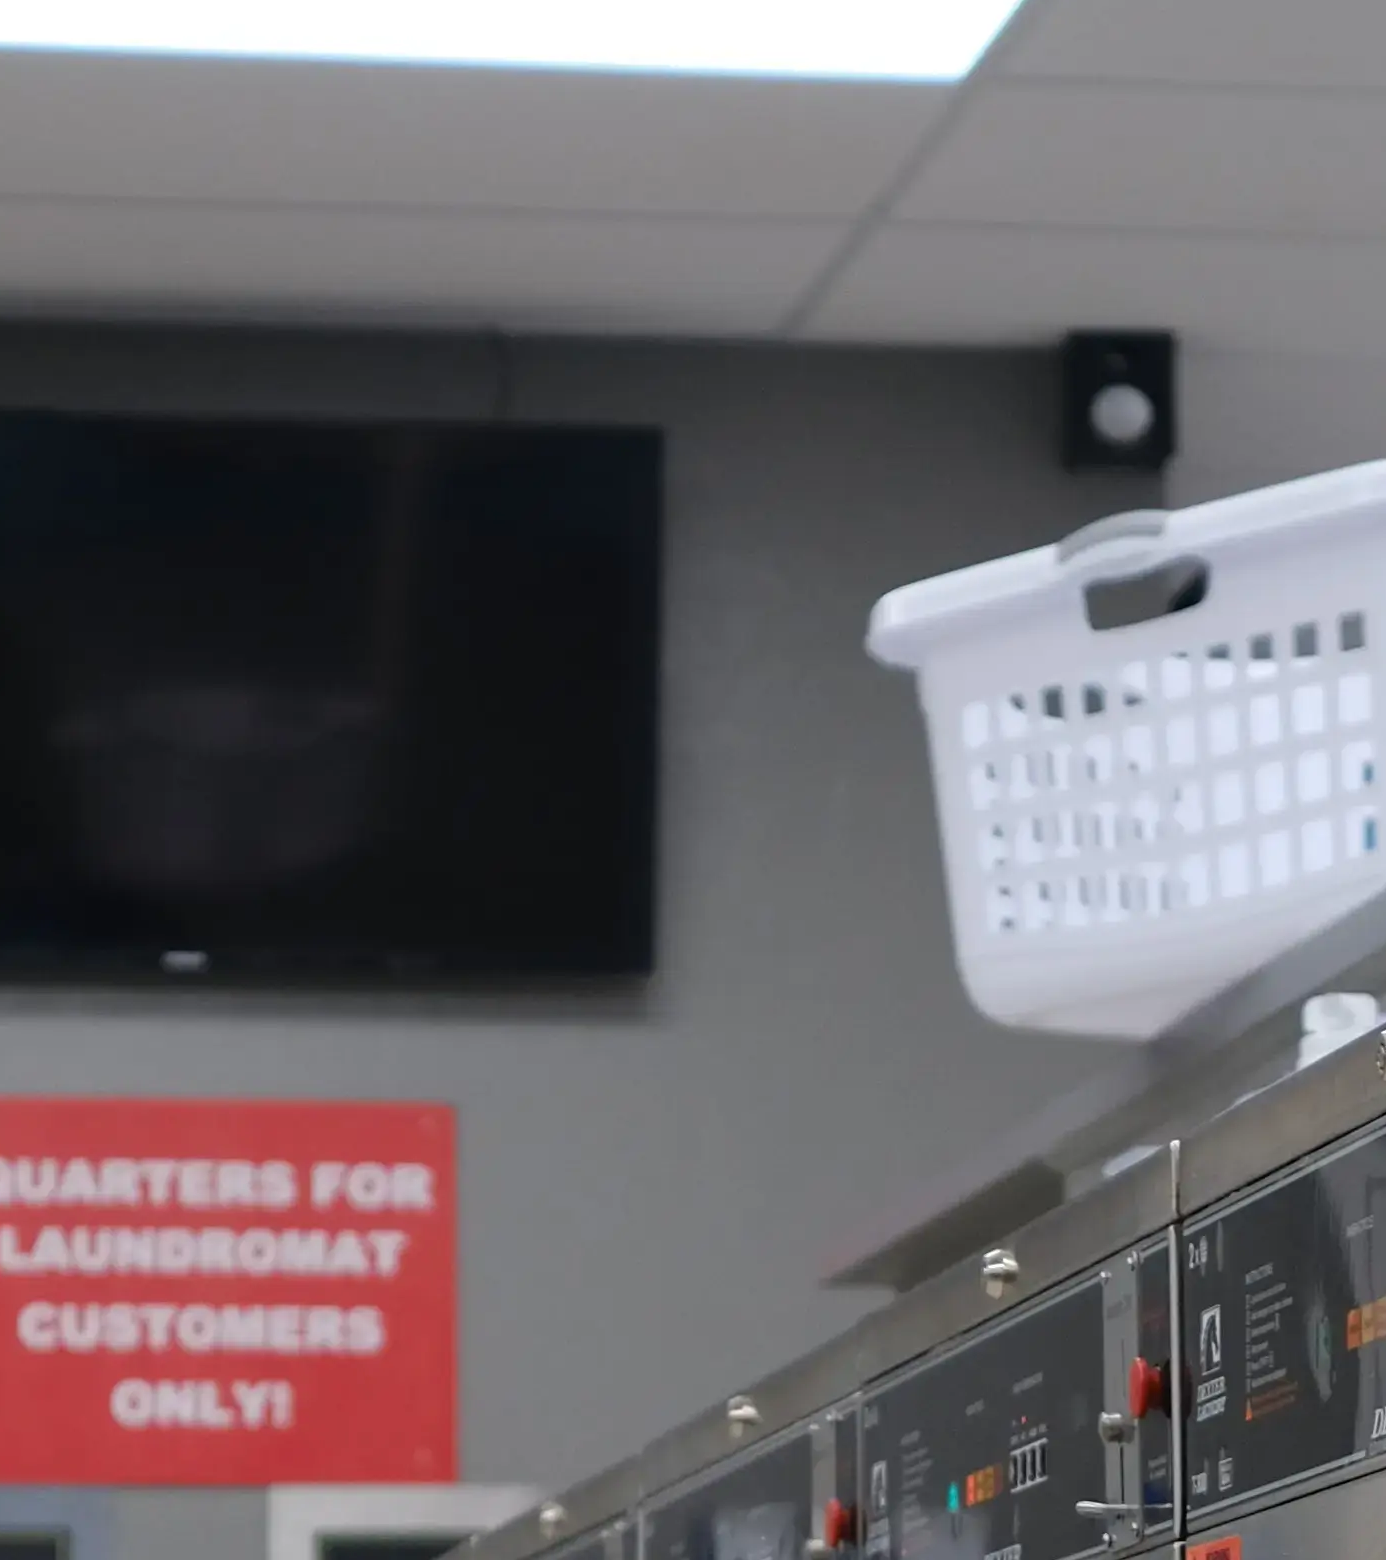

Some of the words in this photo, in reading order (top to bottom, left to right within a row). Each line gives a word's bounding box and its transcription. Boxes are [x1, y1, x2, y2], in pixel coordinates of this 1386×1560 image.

[311, 1161, 435, 1211] FOR
[16, 1301, 387, 1356] CUSTOMERS
[110, 1378, 295, 1430] ONLY!
